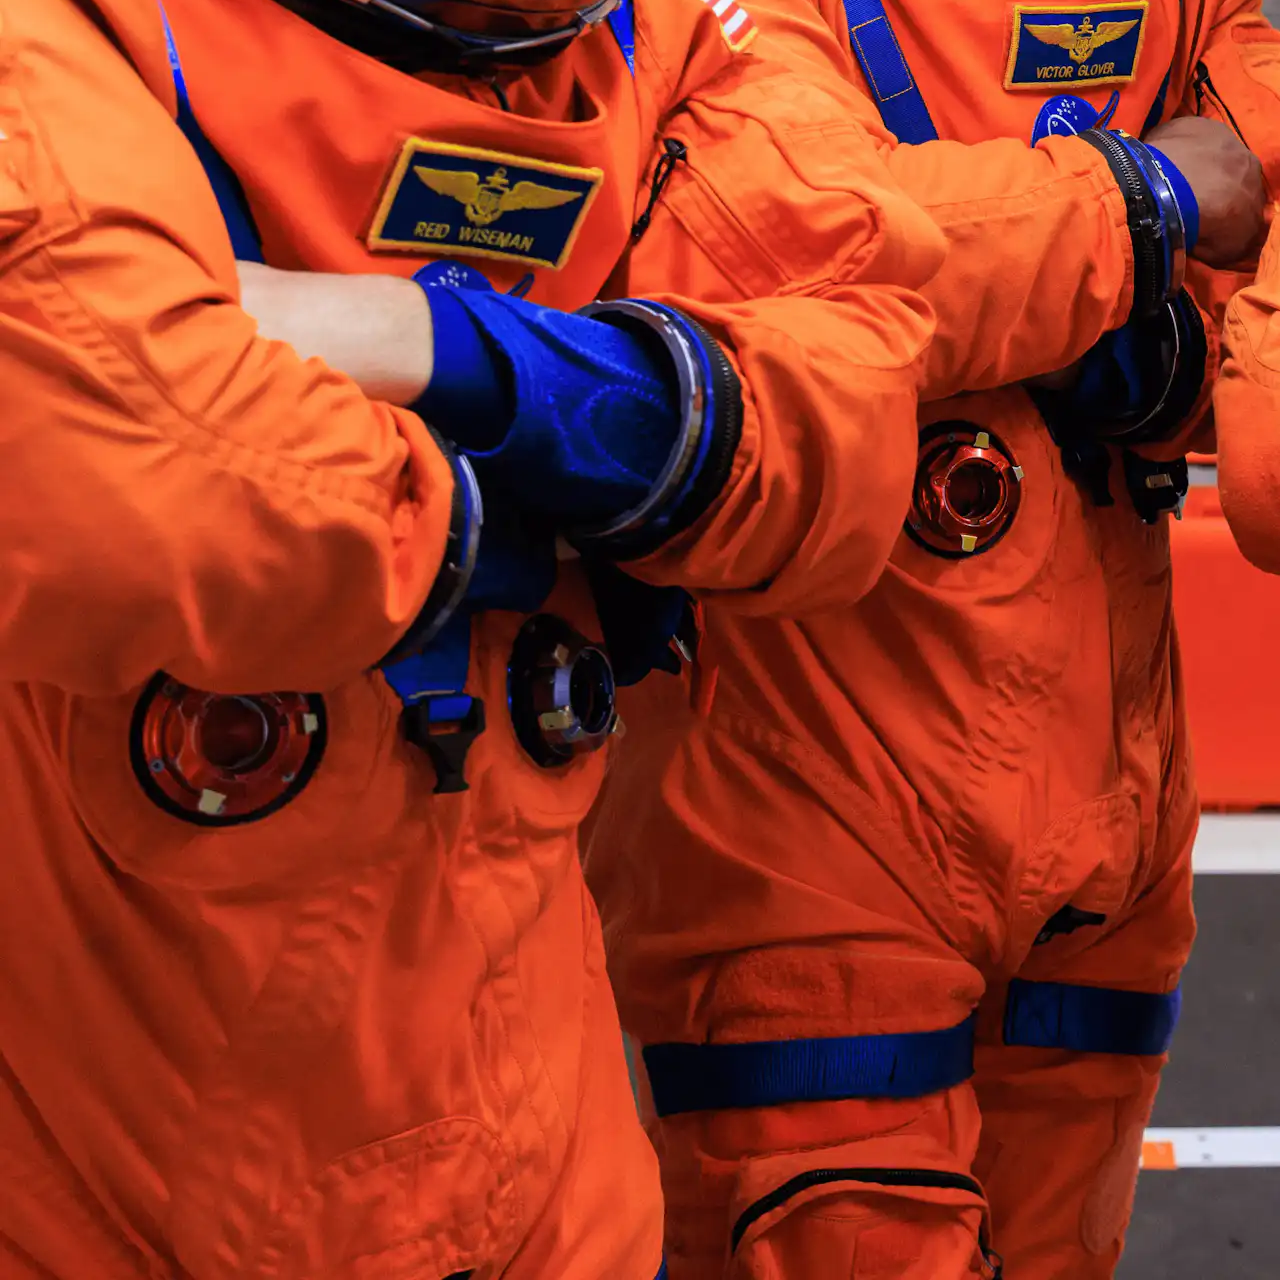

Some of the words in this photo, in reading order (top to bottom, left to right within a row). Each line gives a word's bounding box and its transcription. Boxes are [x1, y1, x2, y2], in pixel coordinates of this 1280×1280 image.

[1036, 65, 1074, 79] VICTOR
[1077, 62, 1115, 77] GLOVER
[413, 221, 450, 239] REID
[459, 226, 535, 252] WISEMAN
